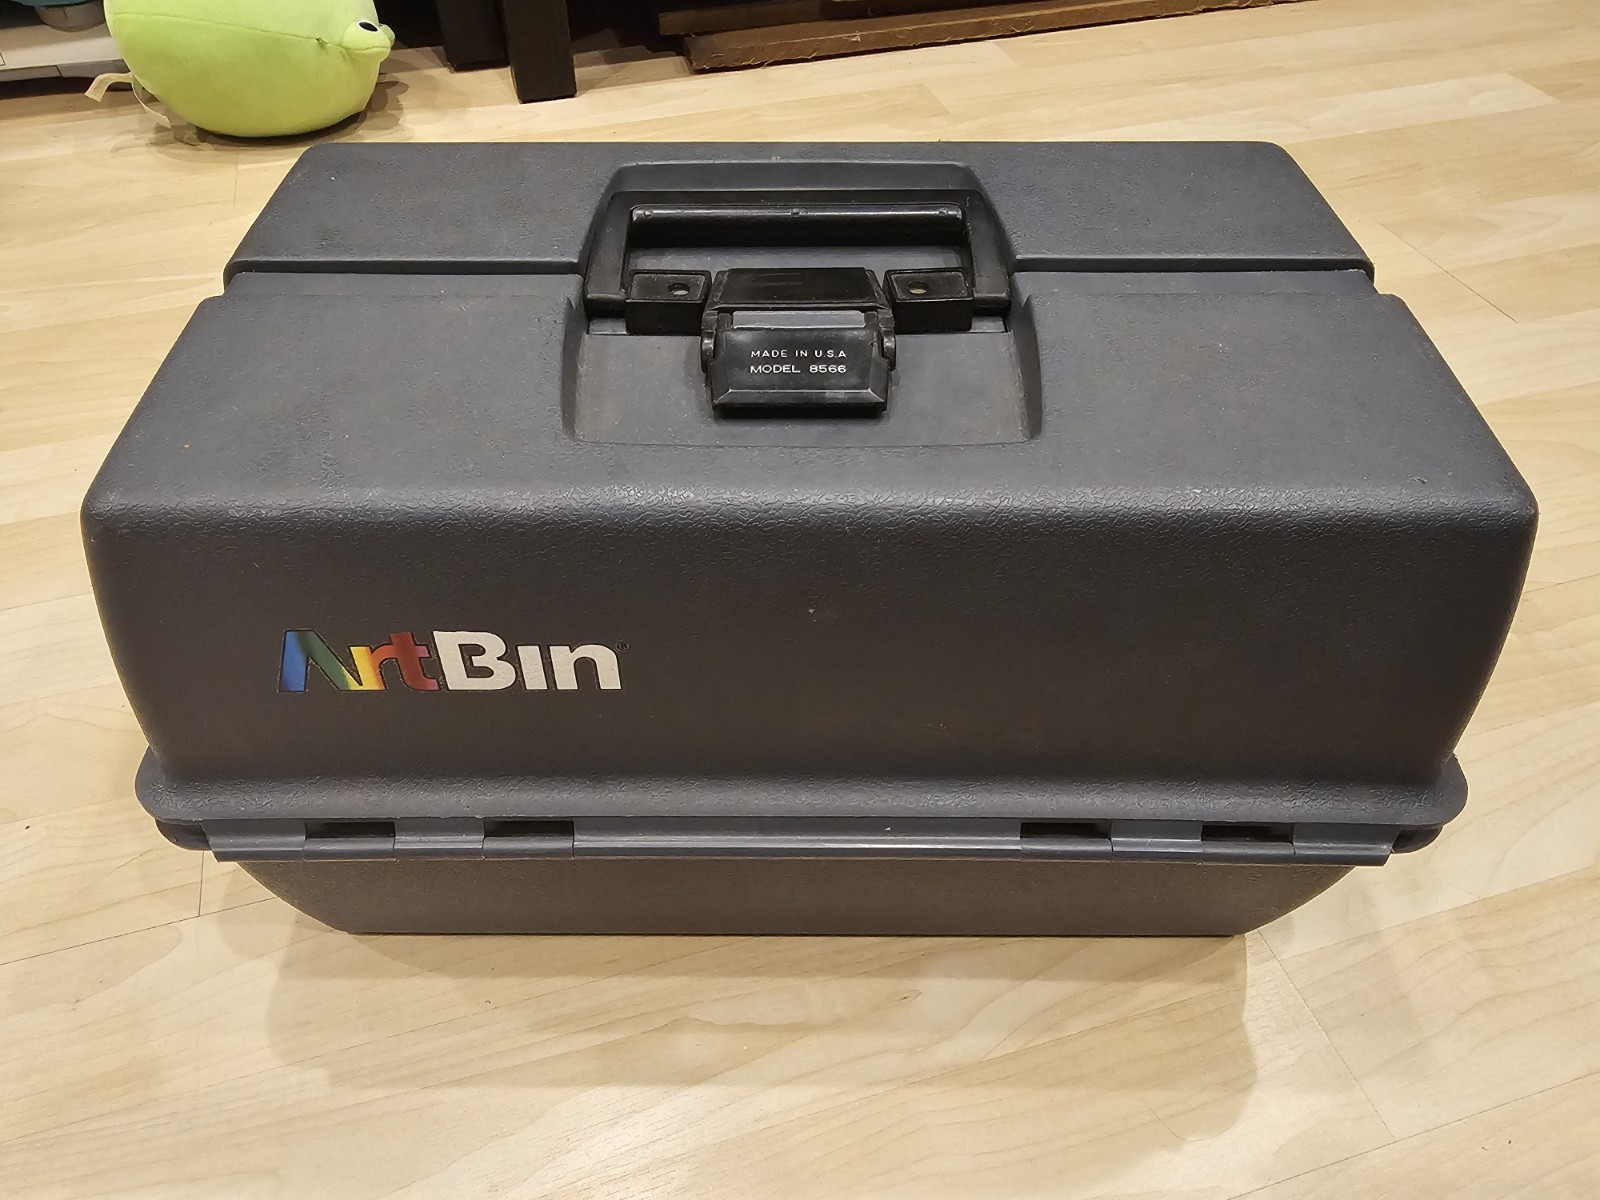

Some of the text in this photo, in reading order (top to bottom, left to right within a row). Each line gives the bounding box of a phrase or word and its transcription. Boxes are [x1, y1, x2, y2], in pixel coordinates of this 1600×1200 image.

[750, 349, 788, 358] MADE
[795, 349, 808, 358] IN
[749, 364, 847, 374] MODEL 8566
[278, 629, 623, 692] ArtBin
